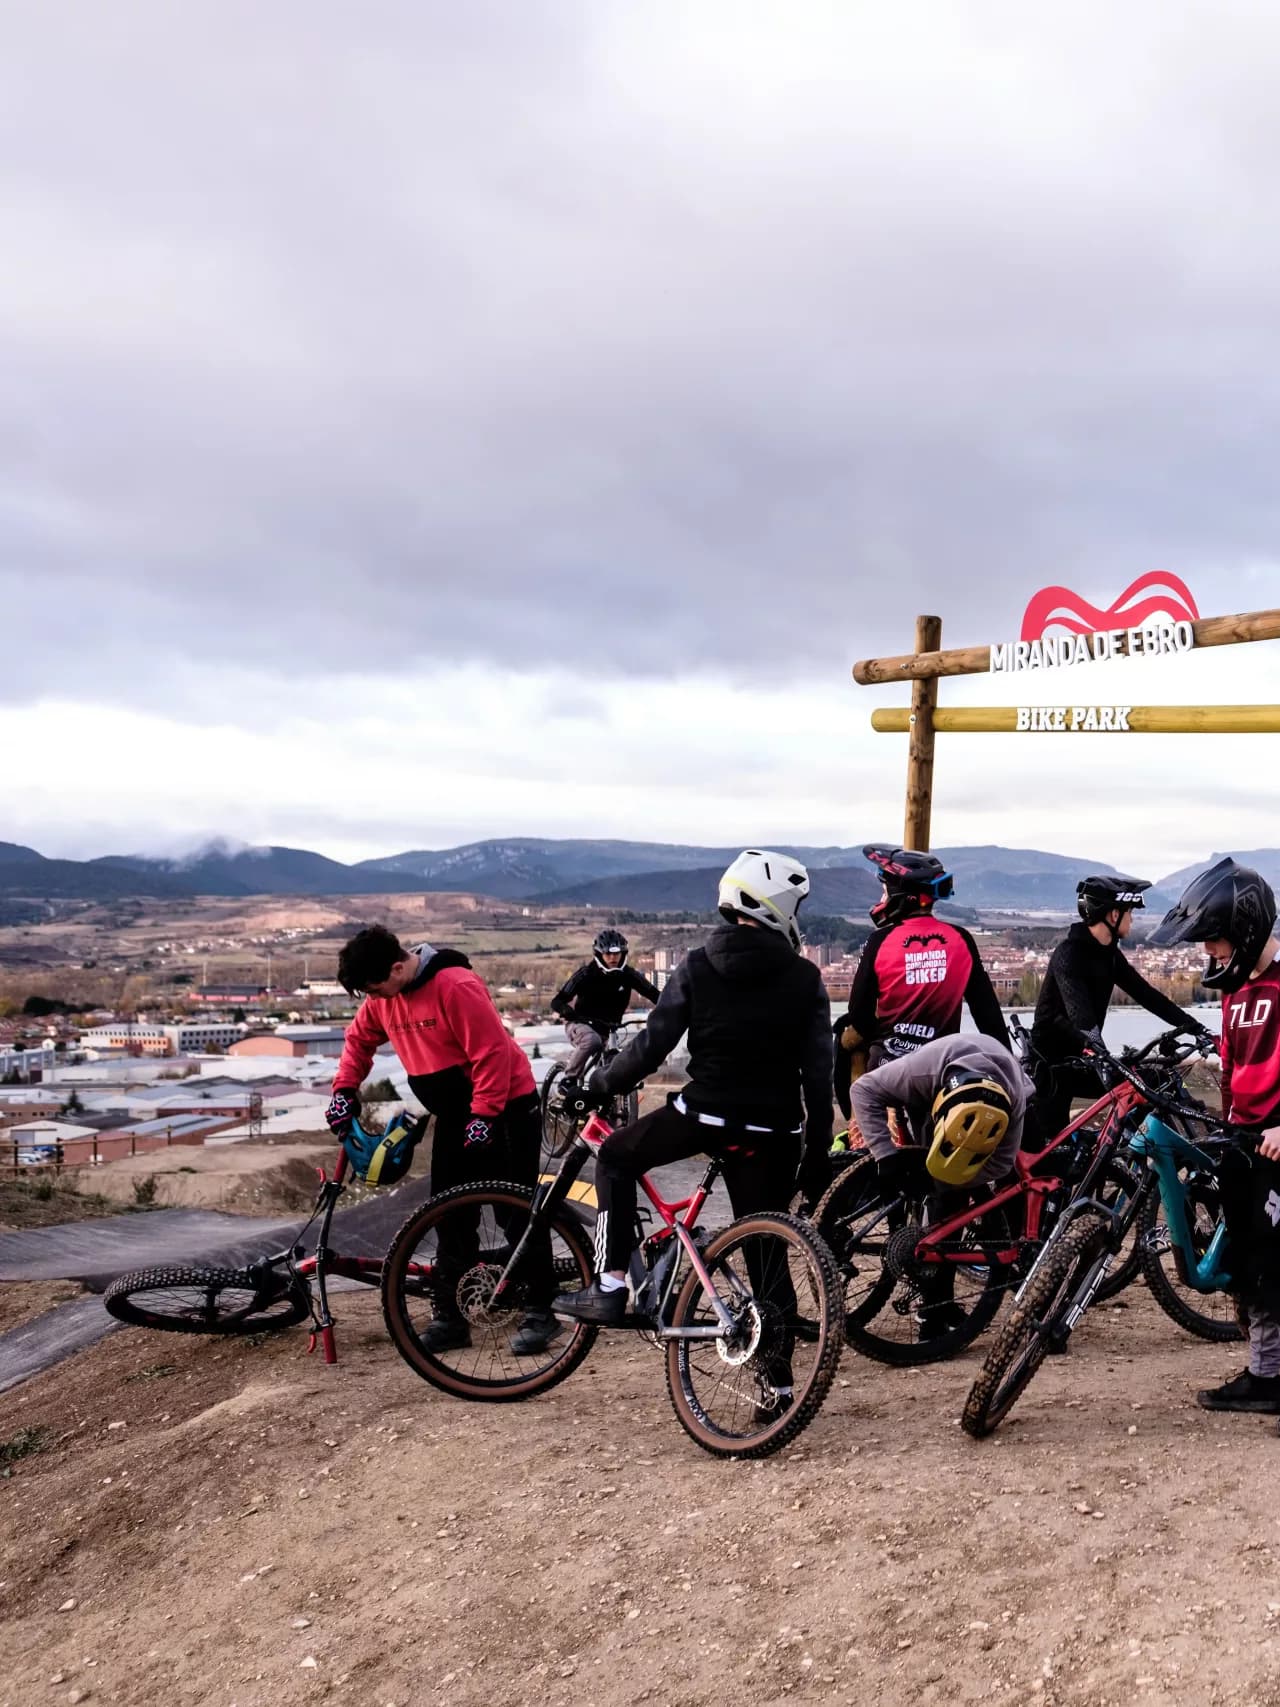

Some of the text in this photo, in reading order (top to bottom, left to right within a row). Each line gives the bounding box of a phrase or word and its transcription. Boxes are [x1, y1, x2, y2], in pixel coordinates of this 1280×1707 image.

[989, 621, 1194, 673] MIRANDA DE EBRO
[1016, 706, 1132, 731] BIKE PARK
[904, 949, 947, 963] MIRANDA
[905, 967, 947, 985] BIKER
[1230, 999, 1272, 1030] TLD
